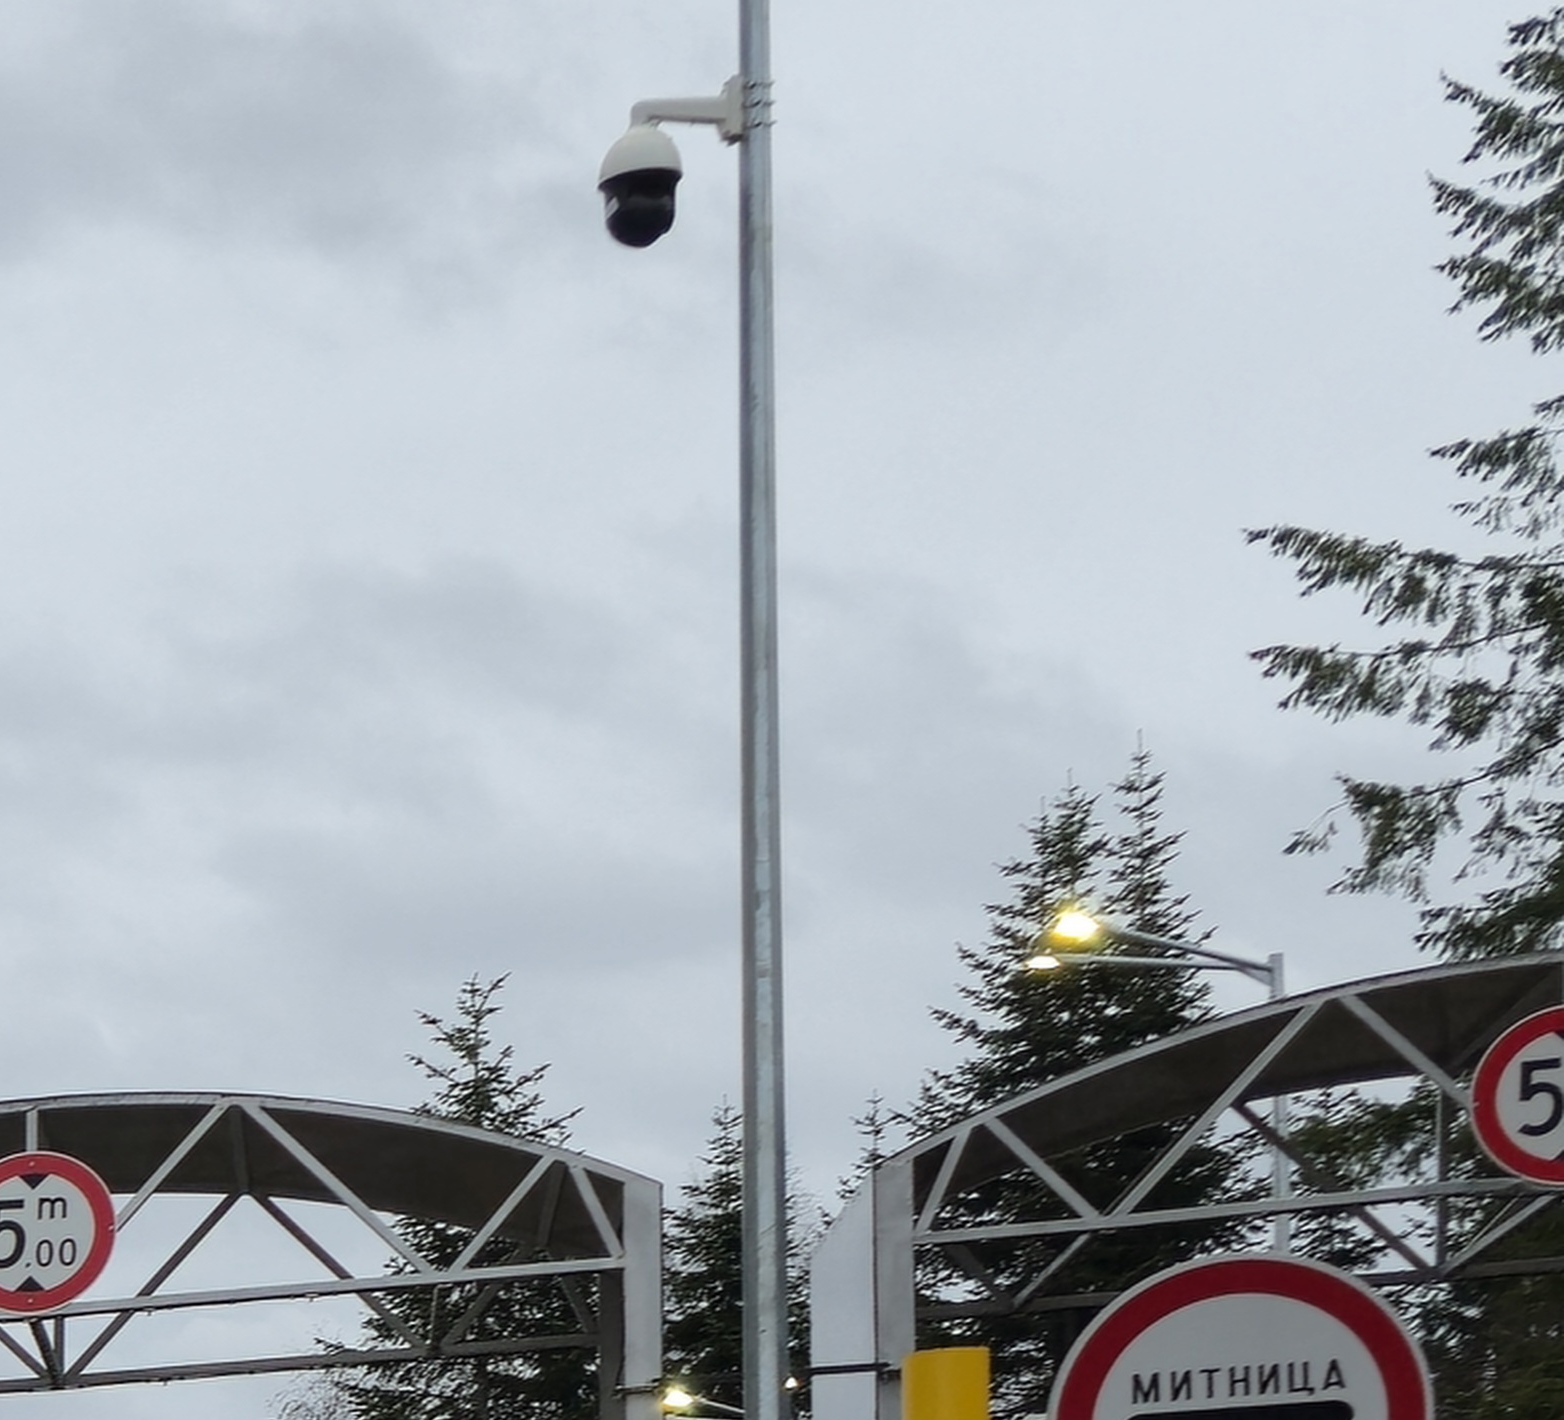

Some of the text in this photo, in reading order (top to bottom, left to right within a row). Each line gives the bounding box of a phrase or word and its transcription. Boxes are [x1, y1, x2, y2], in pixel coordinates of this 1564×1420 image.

[1518, 1058, 1563, 1136] 5
[38, 1196, 68, 1220] m
[1131, 1358, 1347, 1404] МИТНИЦА
